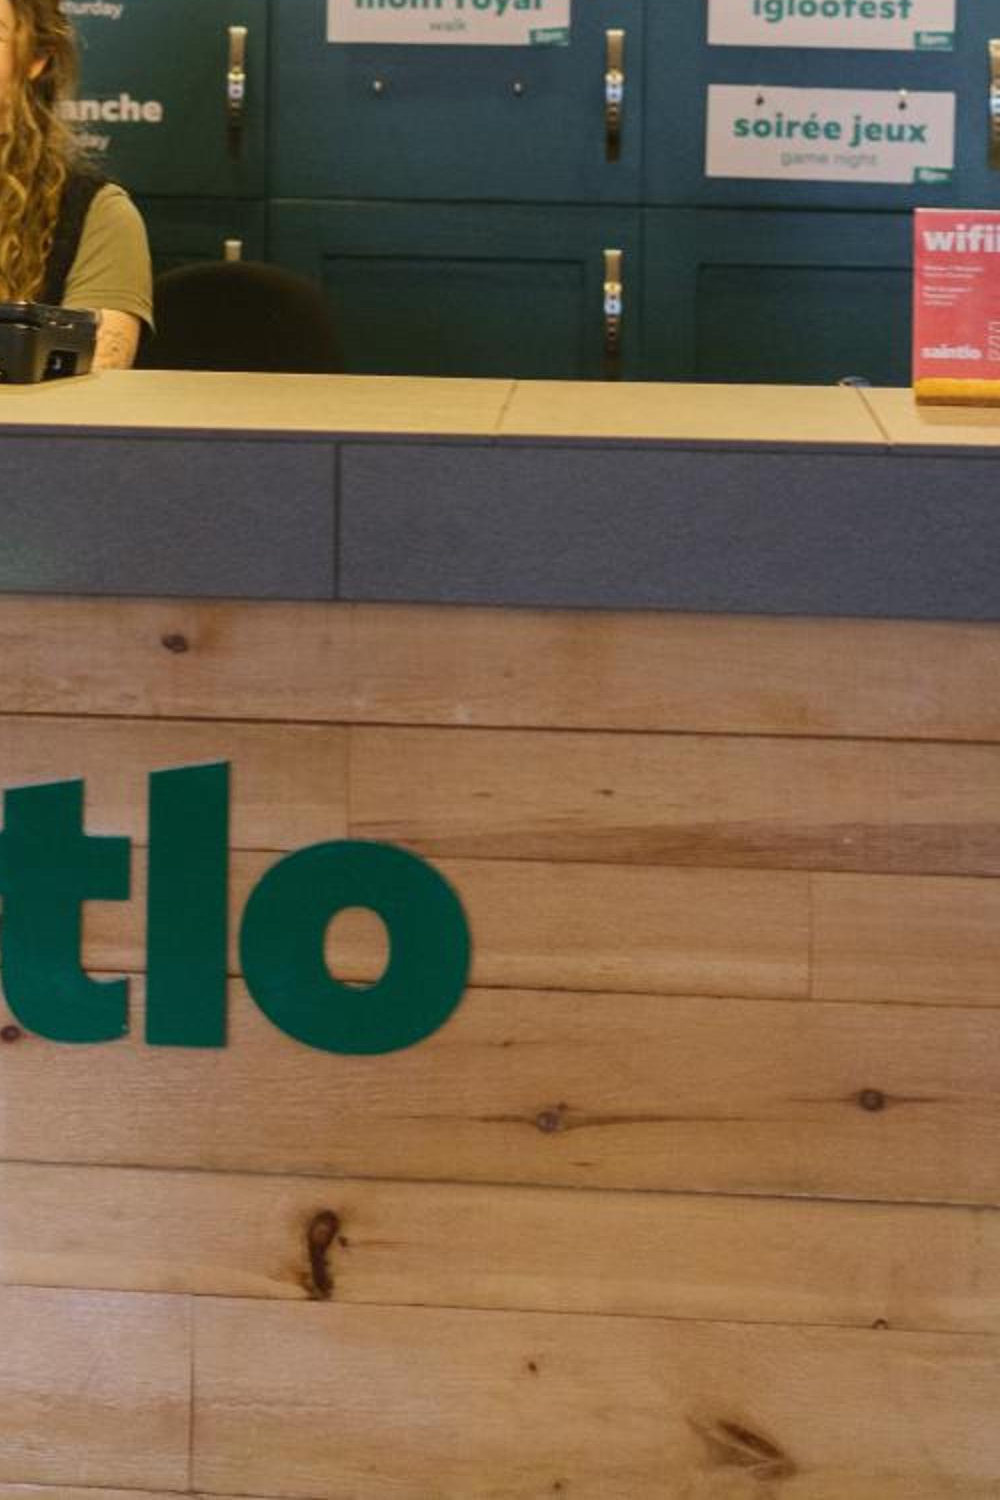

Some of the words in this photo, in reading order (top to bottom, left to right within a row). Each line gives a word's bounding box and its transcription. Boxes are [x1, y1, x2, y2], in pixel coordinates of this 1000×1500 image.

[58, 93, 162, 123] anche
[732, 112, 842, 141] soirée
[849, 115, 927, 148] jeux
